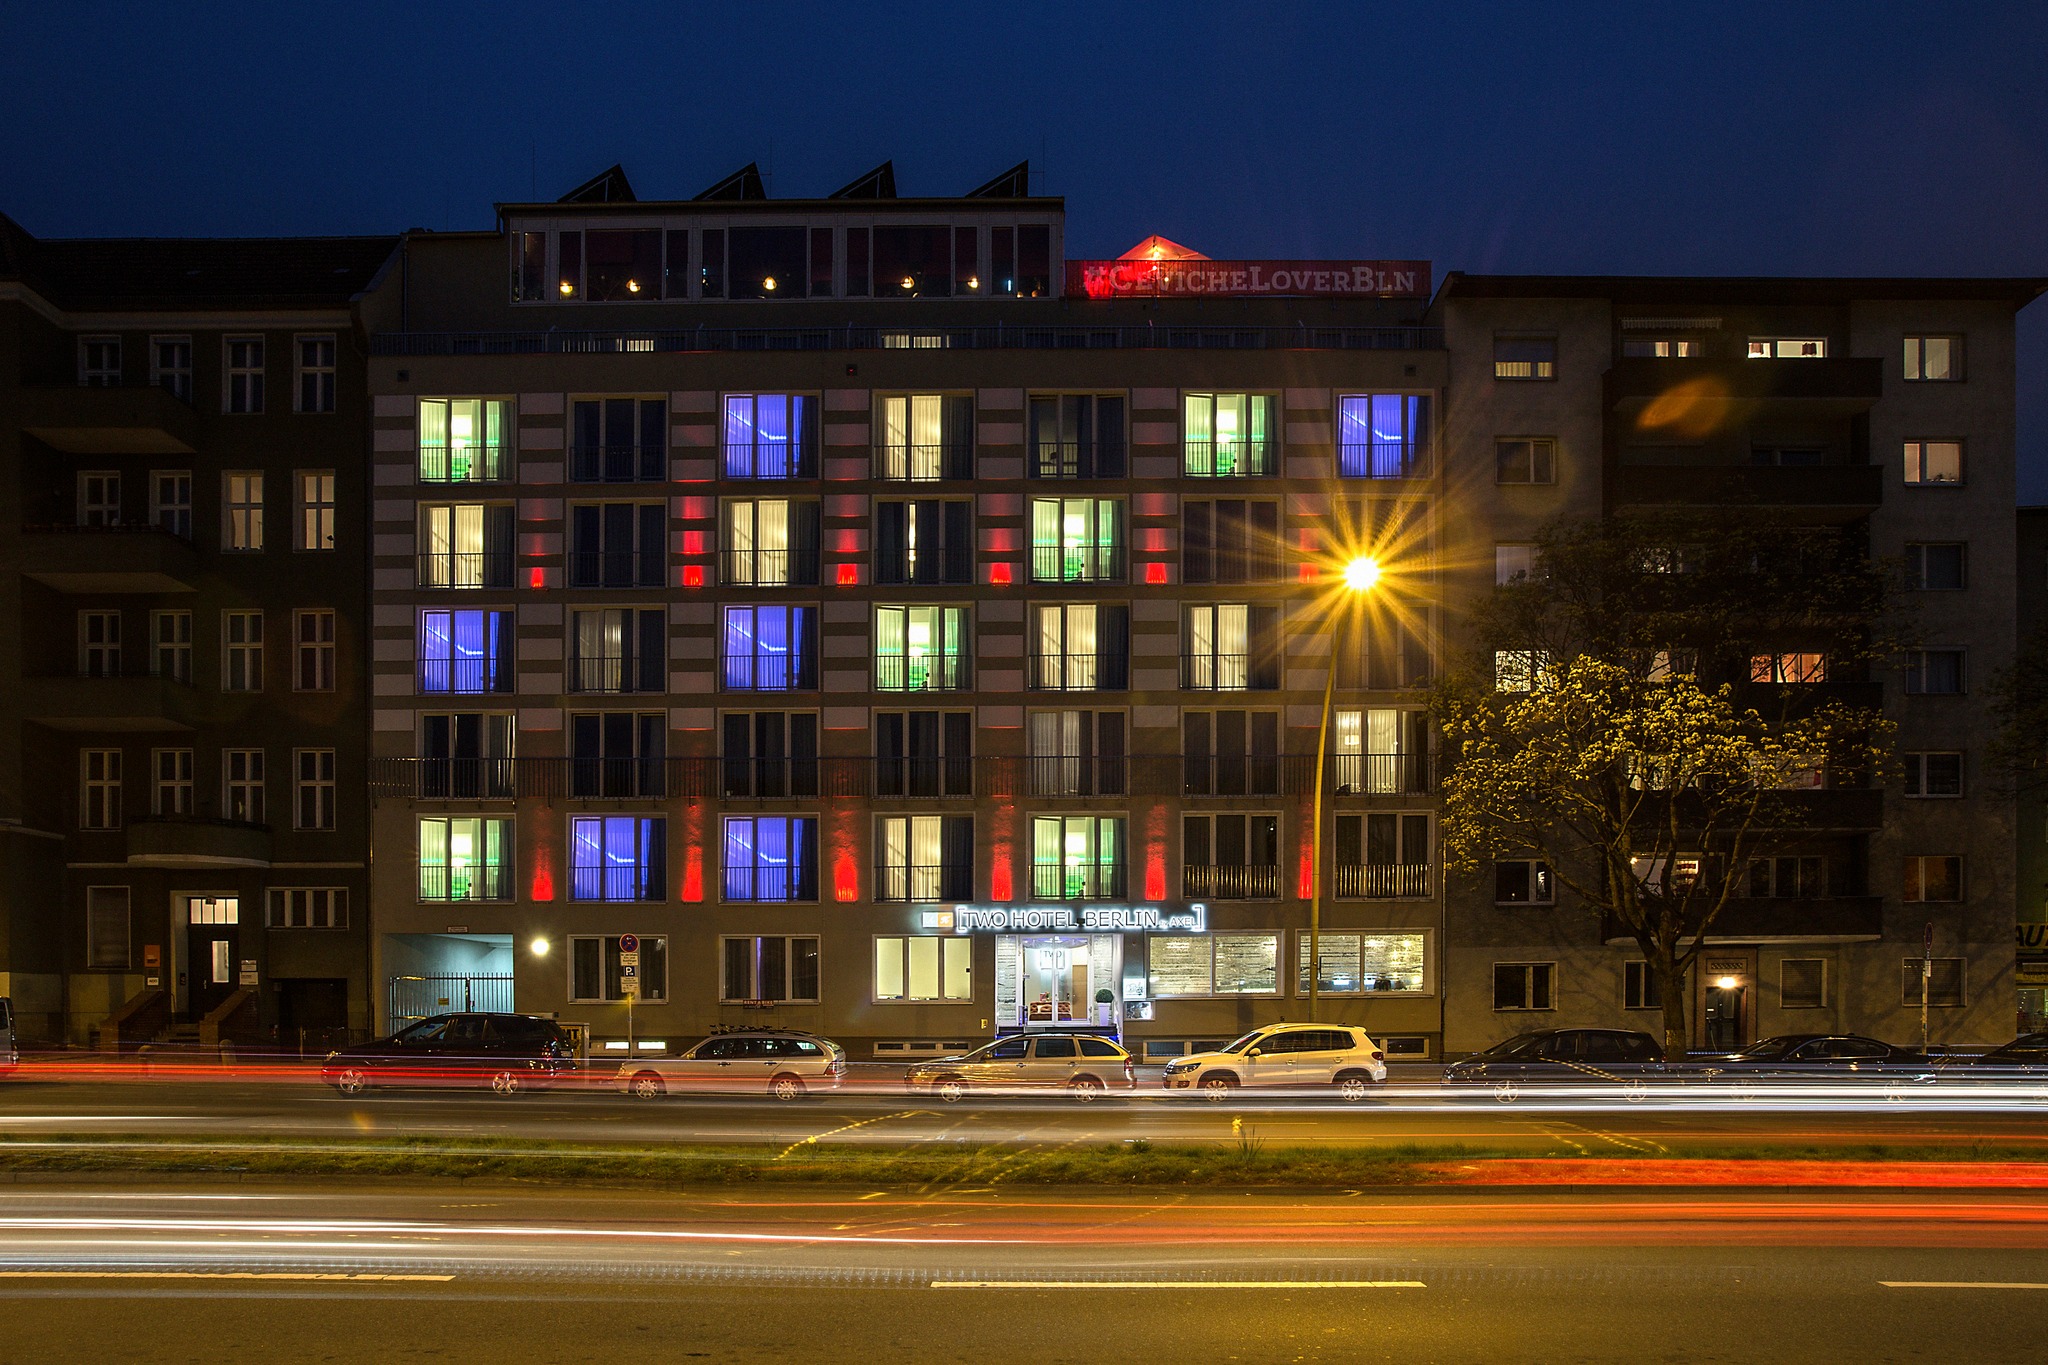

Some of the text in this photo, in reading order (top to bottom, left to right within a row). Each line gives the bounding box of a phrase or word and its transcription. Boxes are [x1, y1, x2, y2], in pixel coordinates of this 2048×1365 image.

[1013, 911, 1077, 927] HOTEL
[1085, 911, 1157, 927] BERLIN
[2016, 925, 2048, 946] AU
